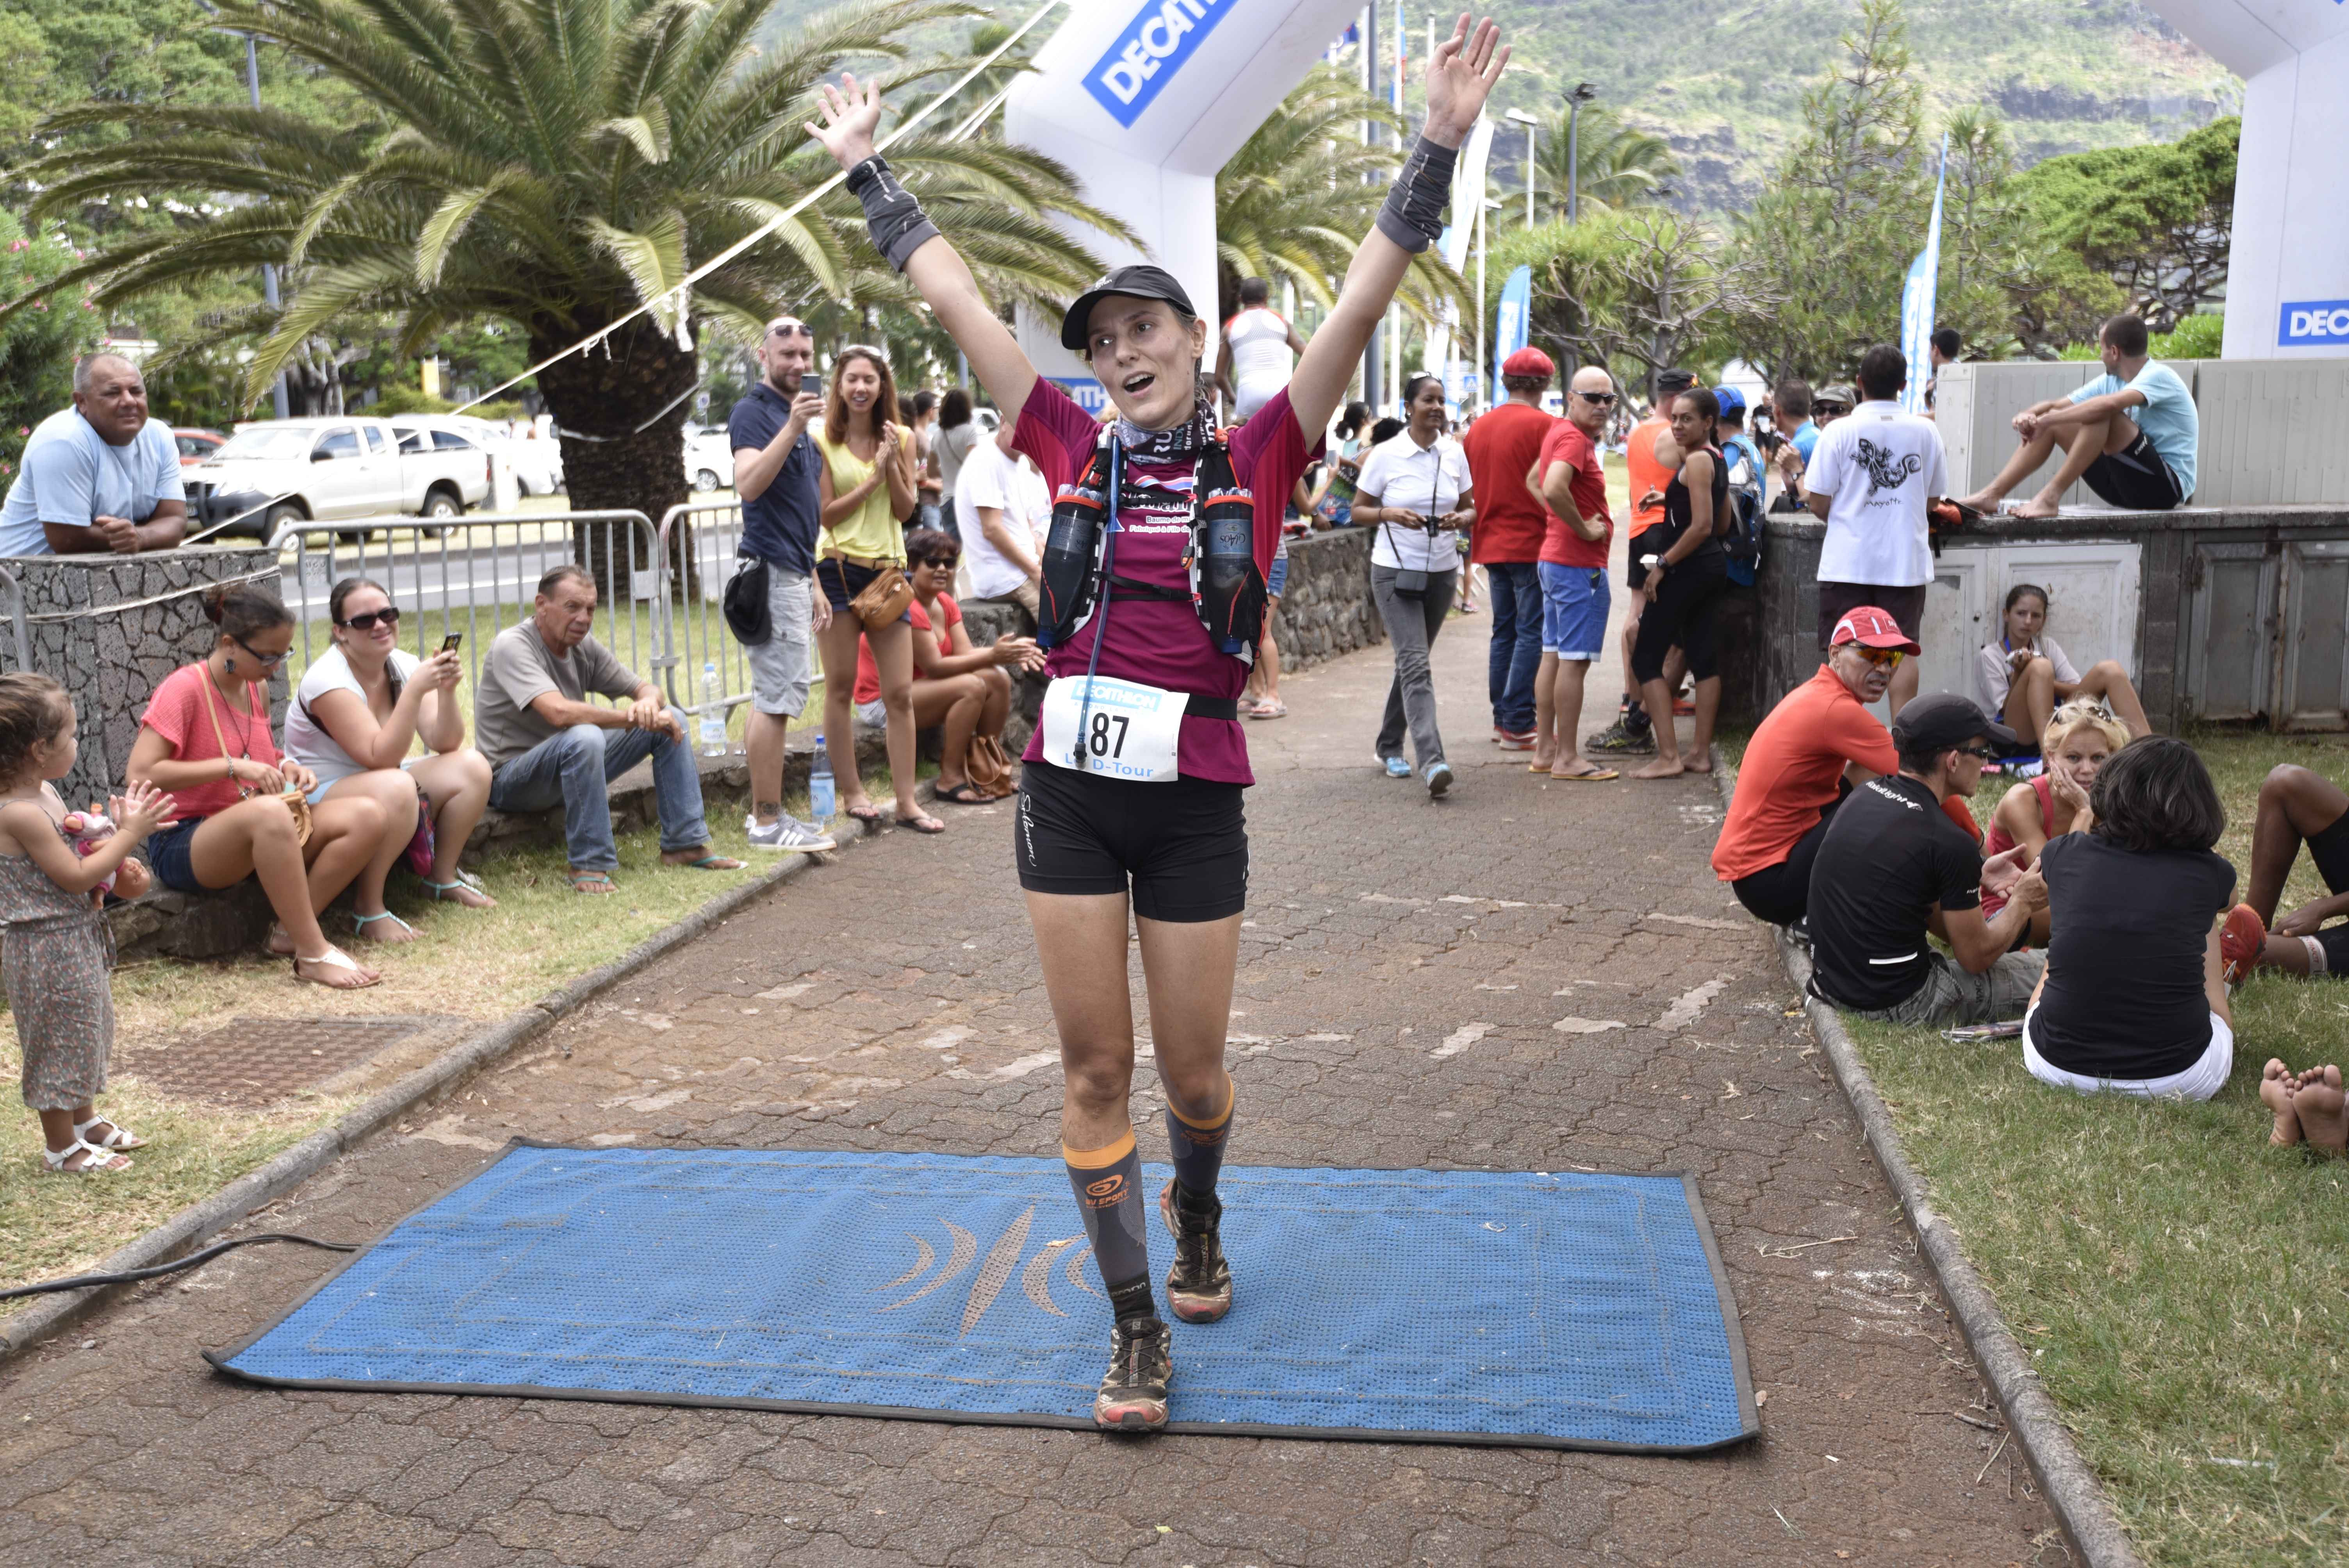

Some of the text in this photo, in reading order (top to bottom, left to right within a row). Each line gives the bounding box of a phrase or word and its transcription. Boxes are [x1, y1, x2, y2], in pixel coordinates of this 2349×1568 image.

[1100, 0, 1218, 106] DECAT
[1153, 428, 1177, 453] RU
[1091, 713, 1130, 759] 87
[1093, 758, 1154, 777] D-Tour
[1021, 791, 1037, 867] Salomon
[1099, 1188, 1129, 1205] SPORT
